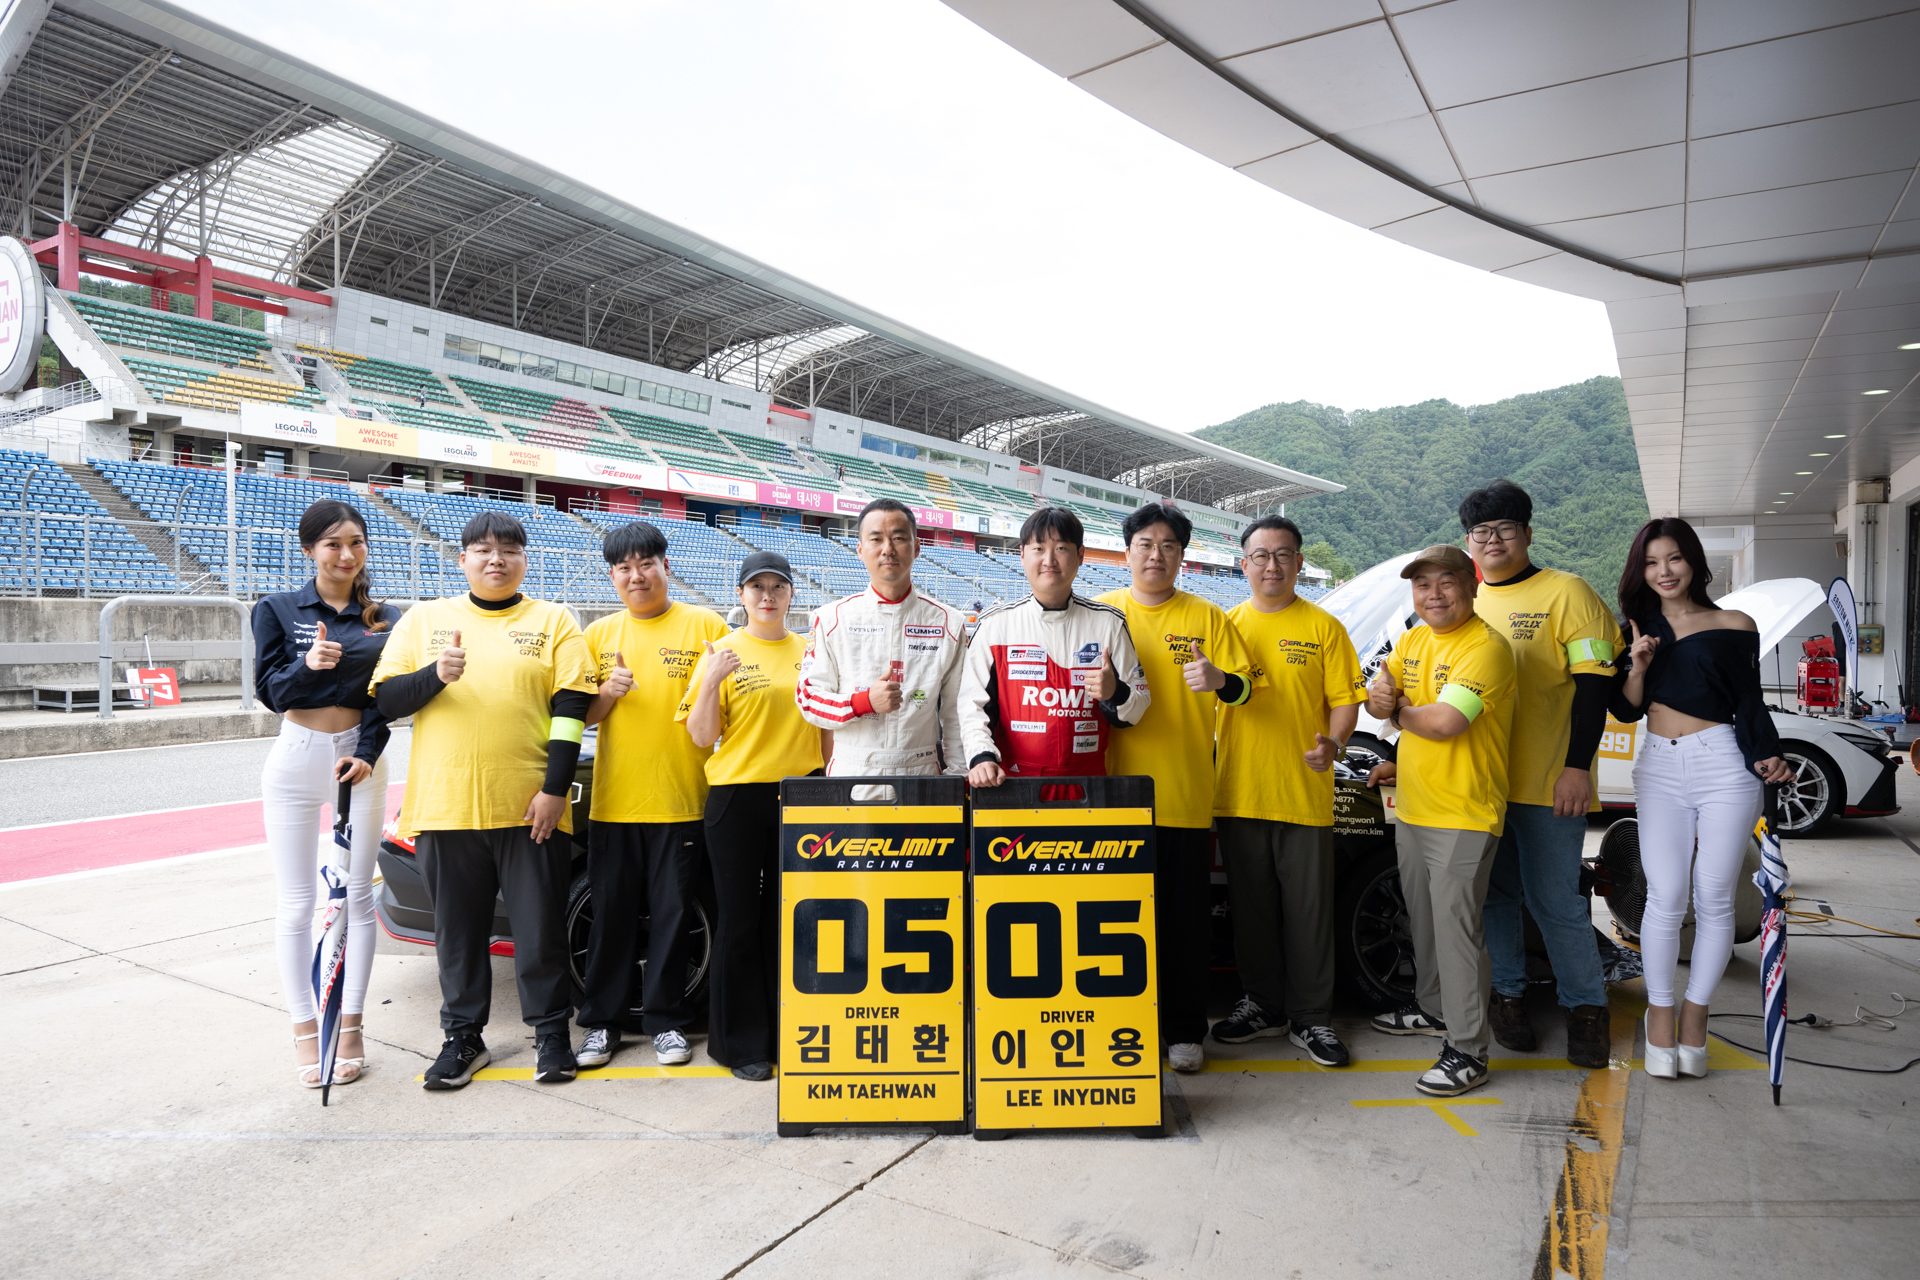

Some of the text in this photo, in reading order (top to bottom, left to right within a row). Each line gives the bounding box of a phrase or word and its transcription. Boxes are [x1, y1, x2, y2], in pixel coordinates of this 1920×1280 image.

[275, 421, 317, 435] LEGOLAND
[358, 428, 399, 439] AWESOME
[362, 437, 395, 447] AWAITS!
[444, 446, 477, 457] LEGOLAND
[509, 451, 540, 460] AWESOME
[512, 458, 538, 467] AWAITS!
[797, 491, 821, 507] 데시앙
[1510, 620, 1542, 628] NFLIX
[514, 638, 546, 648] NFLIX
[520, 649, 541, 659] GYM
[663, 657, 694, 667] NFLIX
[1286, 657, 1307, 666] GYM
[1403, 658, 1421, 666] OWE
[735, 664, 760, 675] ROWE
[667, 671, 688, 680] GYM
[1021, 685, 1094, 709] ROWE
[1048, 708, 1080, 717] MOTOR
[796, 831, 956, 859] OVERLIMIT
[987, 834, 1145, 862] OVERLIMIT
[837, 860, 914, 869] RACING
[1028, 862, 1106, 872] RACING
[792, 897, 954, 995] 05
[985, 900, 1148, 999] 05
[845, 1006, 900, 1020] DRIVER
[1040, 1010, 1095, 1024] DRIVER
[807, 1083, 936, 1100] KIM TAEHWAN
[1006, 1087, 1136, 1107] LEE INYONG
